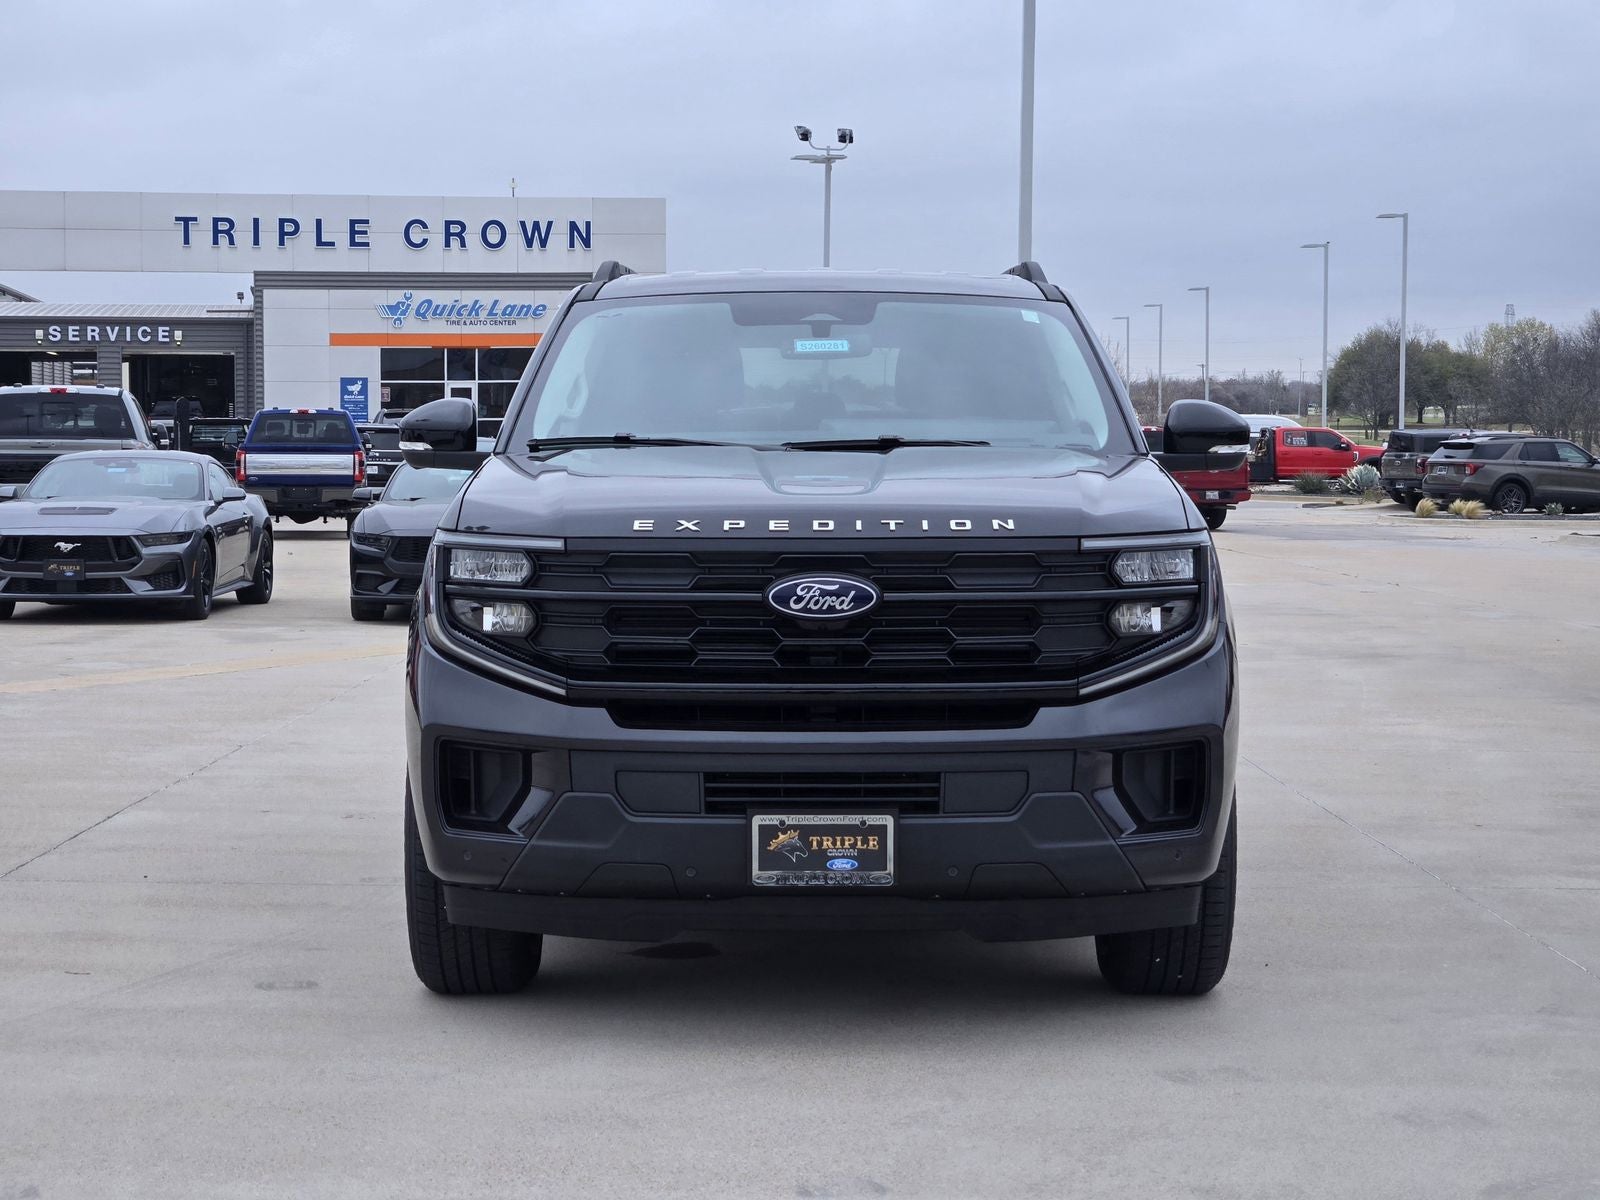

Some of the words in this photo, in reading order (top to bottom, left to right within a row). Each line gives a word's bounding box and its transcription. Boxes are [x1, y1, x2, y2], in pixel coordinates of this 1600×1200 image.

[174, 215, 372, 249] TRIPLE
[403, 218, 593, 251] CROWN
[414, 299, 484, 320] Quick
[486, 299, 548, 318] Lane
[47, 325, 170, 342] SERVICE
[800, 342, 845, 351] S260281
[632, 519, 1016, 531] EXPEDITION
[789, 583, 855, 611] Ford
[759, 815, 887, 823] www.TripleCrownFord.com
[809, 836, 879, 850] TRIPLE
[826, 849, 858, 857] CROWN
[832, 860, 852, 869] Ford
[776, 873, 825, 885] TRIPLE
[827, 873, 871, 885] CROWN
